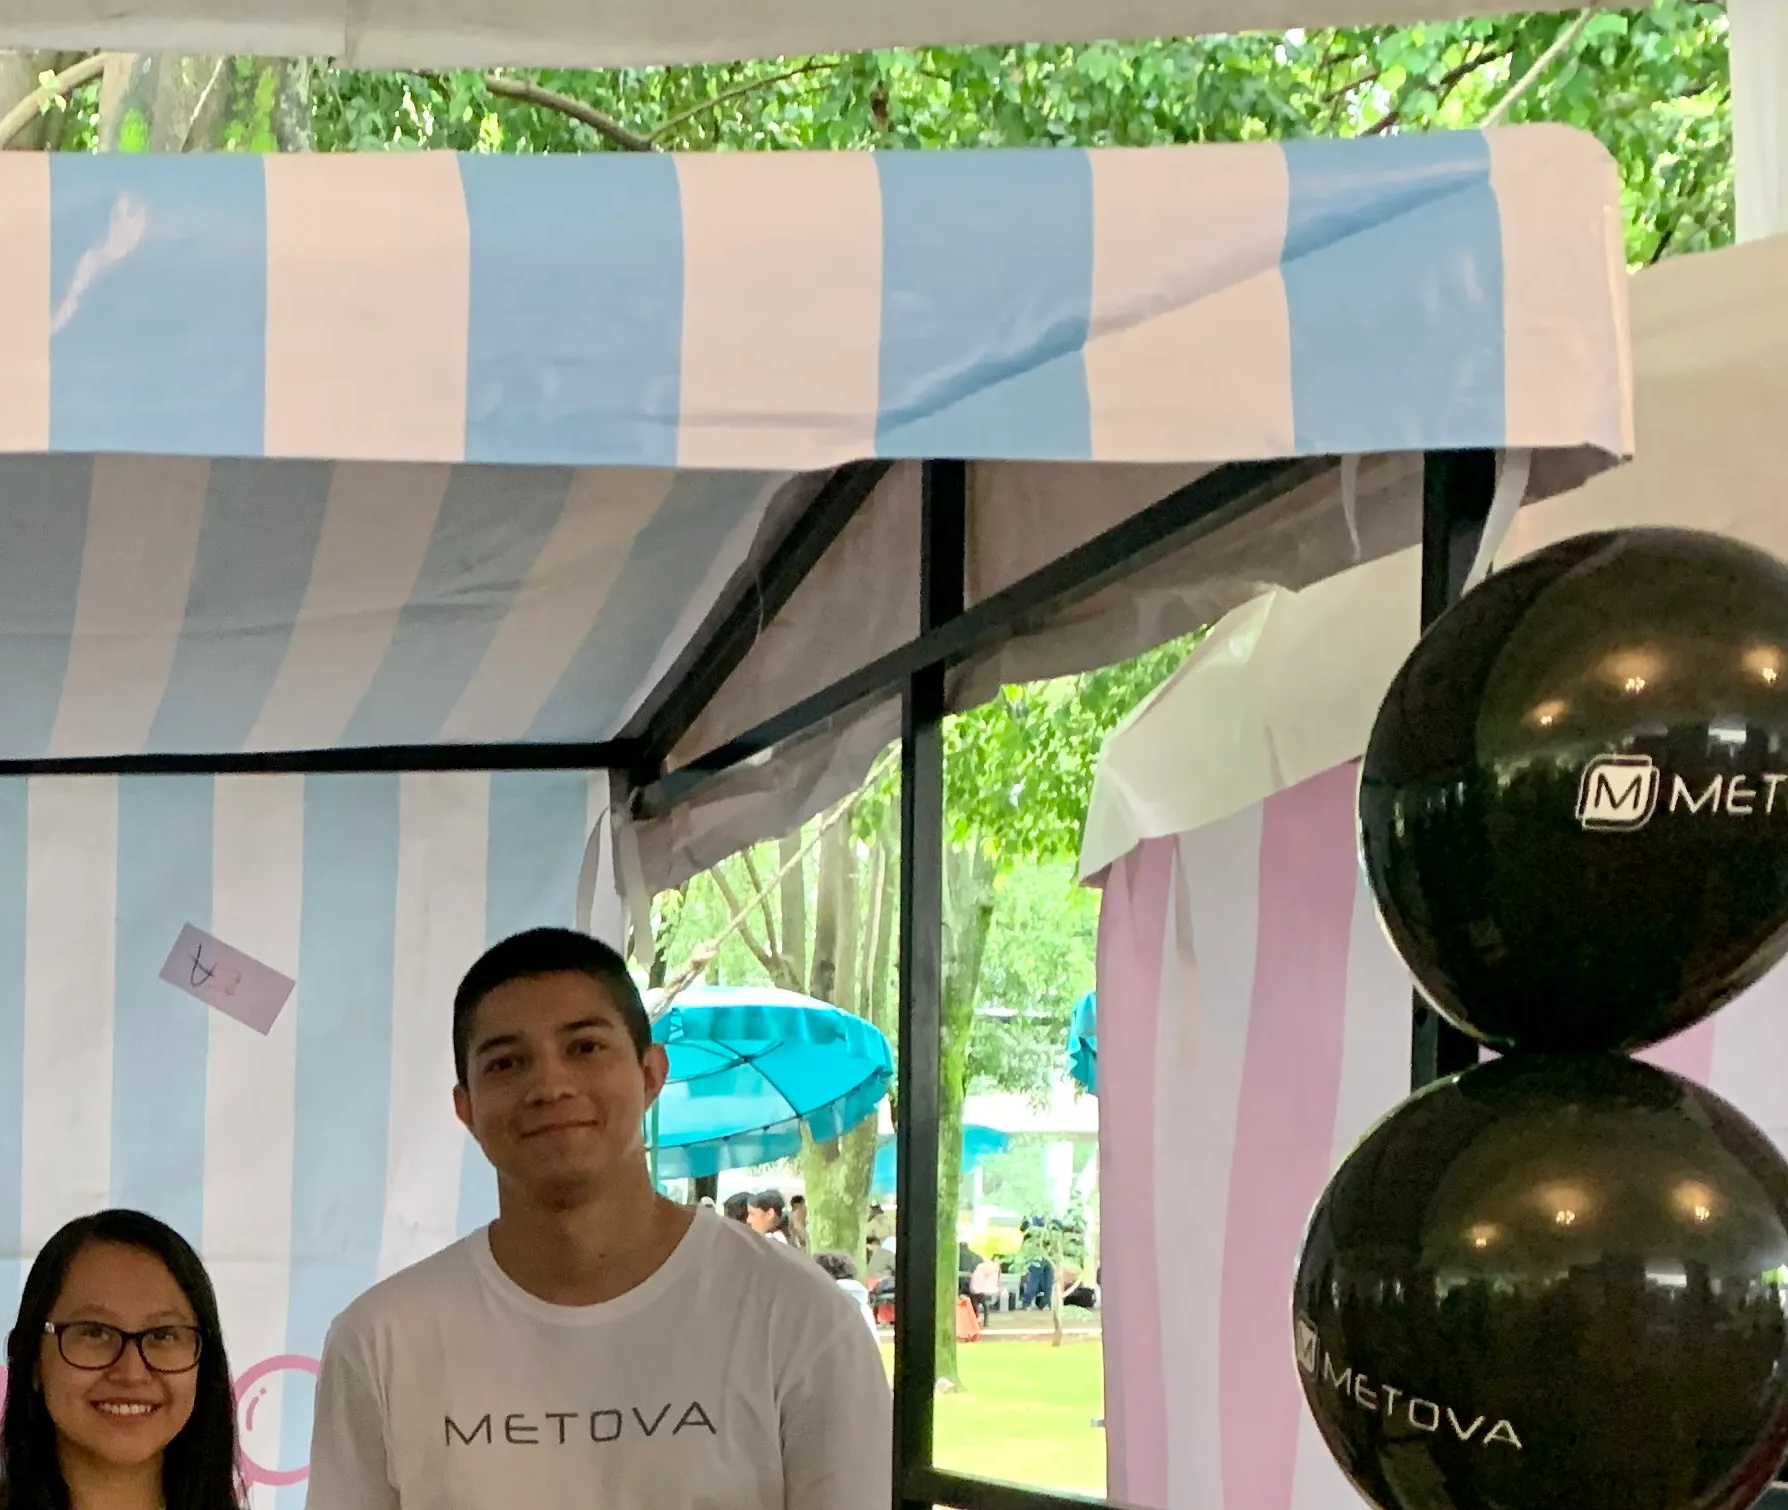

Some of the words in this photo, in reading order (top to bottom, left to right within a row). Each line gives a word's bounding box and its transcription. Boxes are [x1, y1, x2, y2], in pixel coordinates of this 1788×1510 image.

[1668, 772, 1788, 816] MET
[444, 1400, 718, 1447] METOVA
[1323, 1351, 1523, 1449] METOVA
